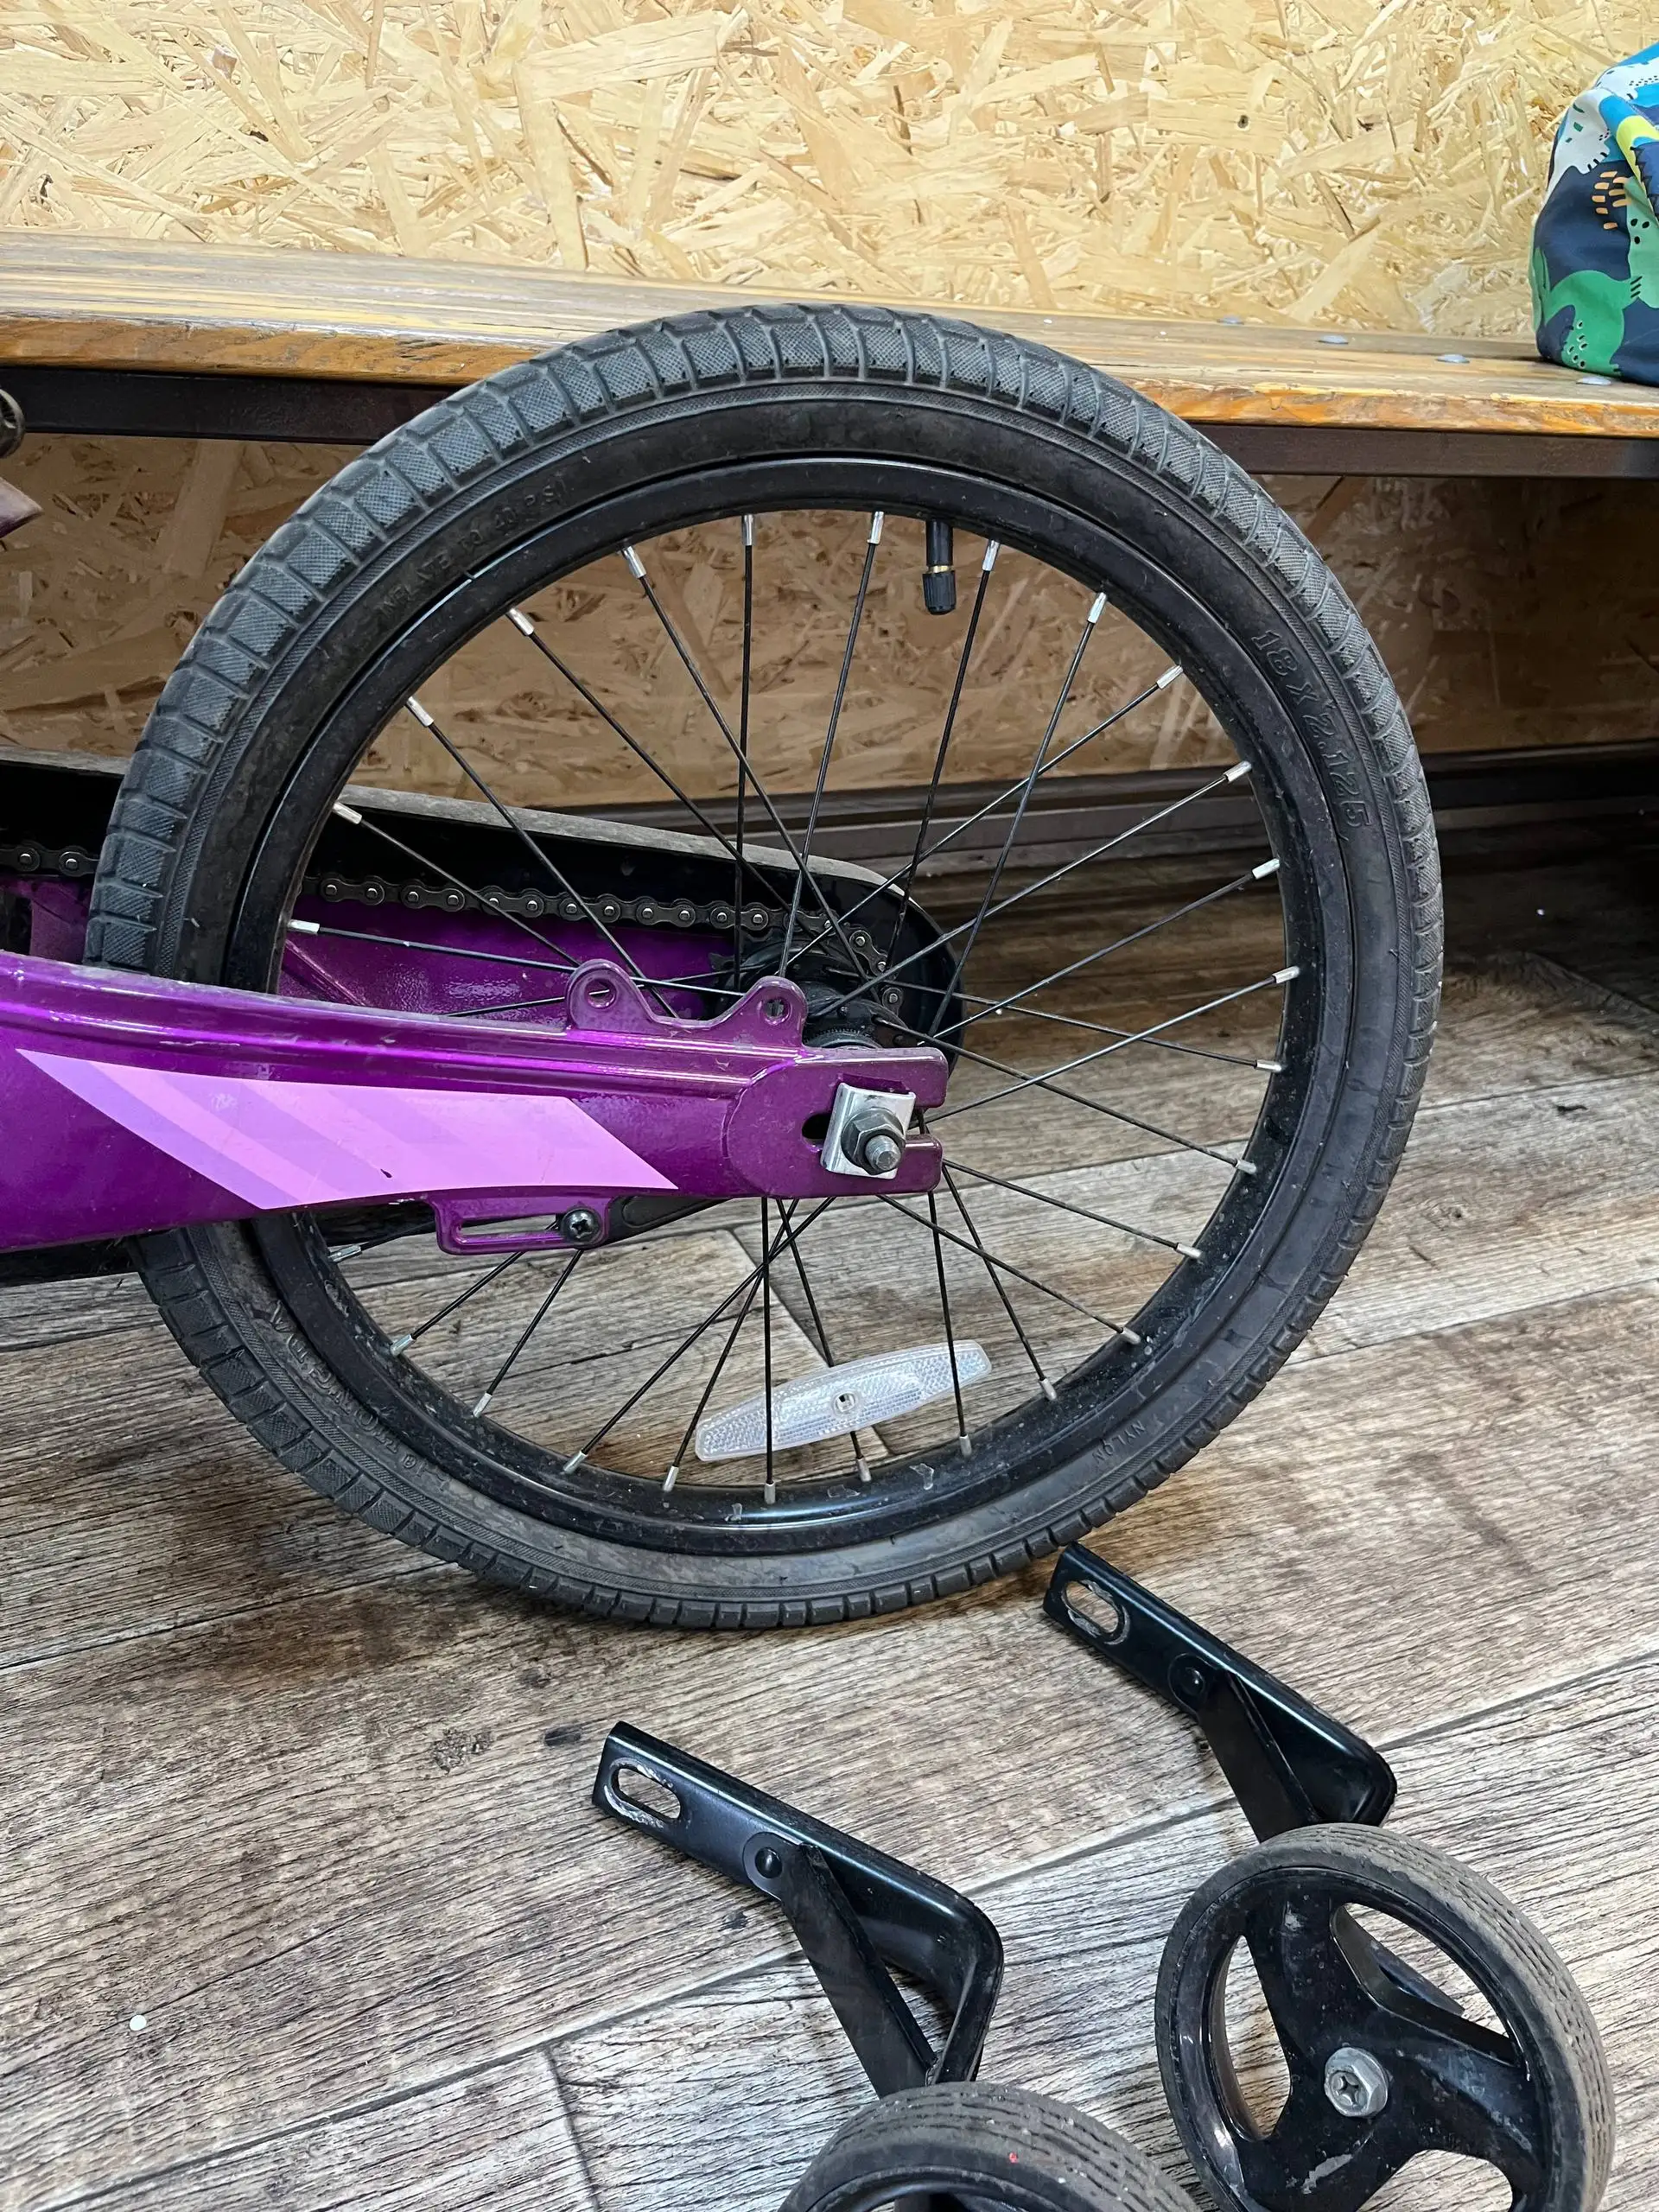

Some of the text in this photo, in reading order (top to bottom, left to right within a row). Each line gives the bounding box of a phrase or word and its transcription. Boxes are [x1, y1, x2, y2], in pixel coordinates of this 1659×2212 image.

[1251, 631, 1298, 676] 18
[1302, 713, 1371, 828] 2.125
[1091, 1420, 1145, 1464] NYLON
